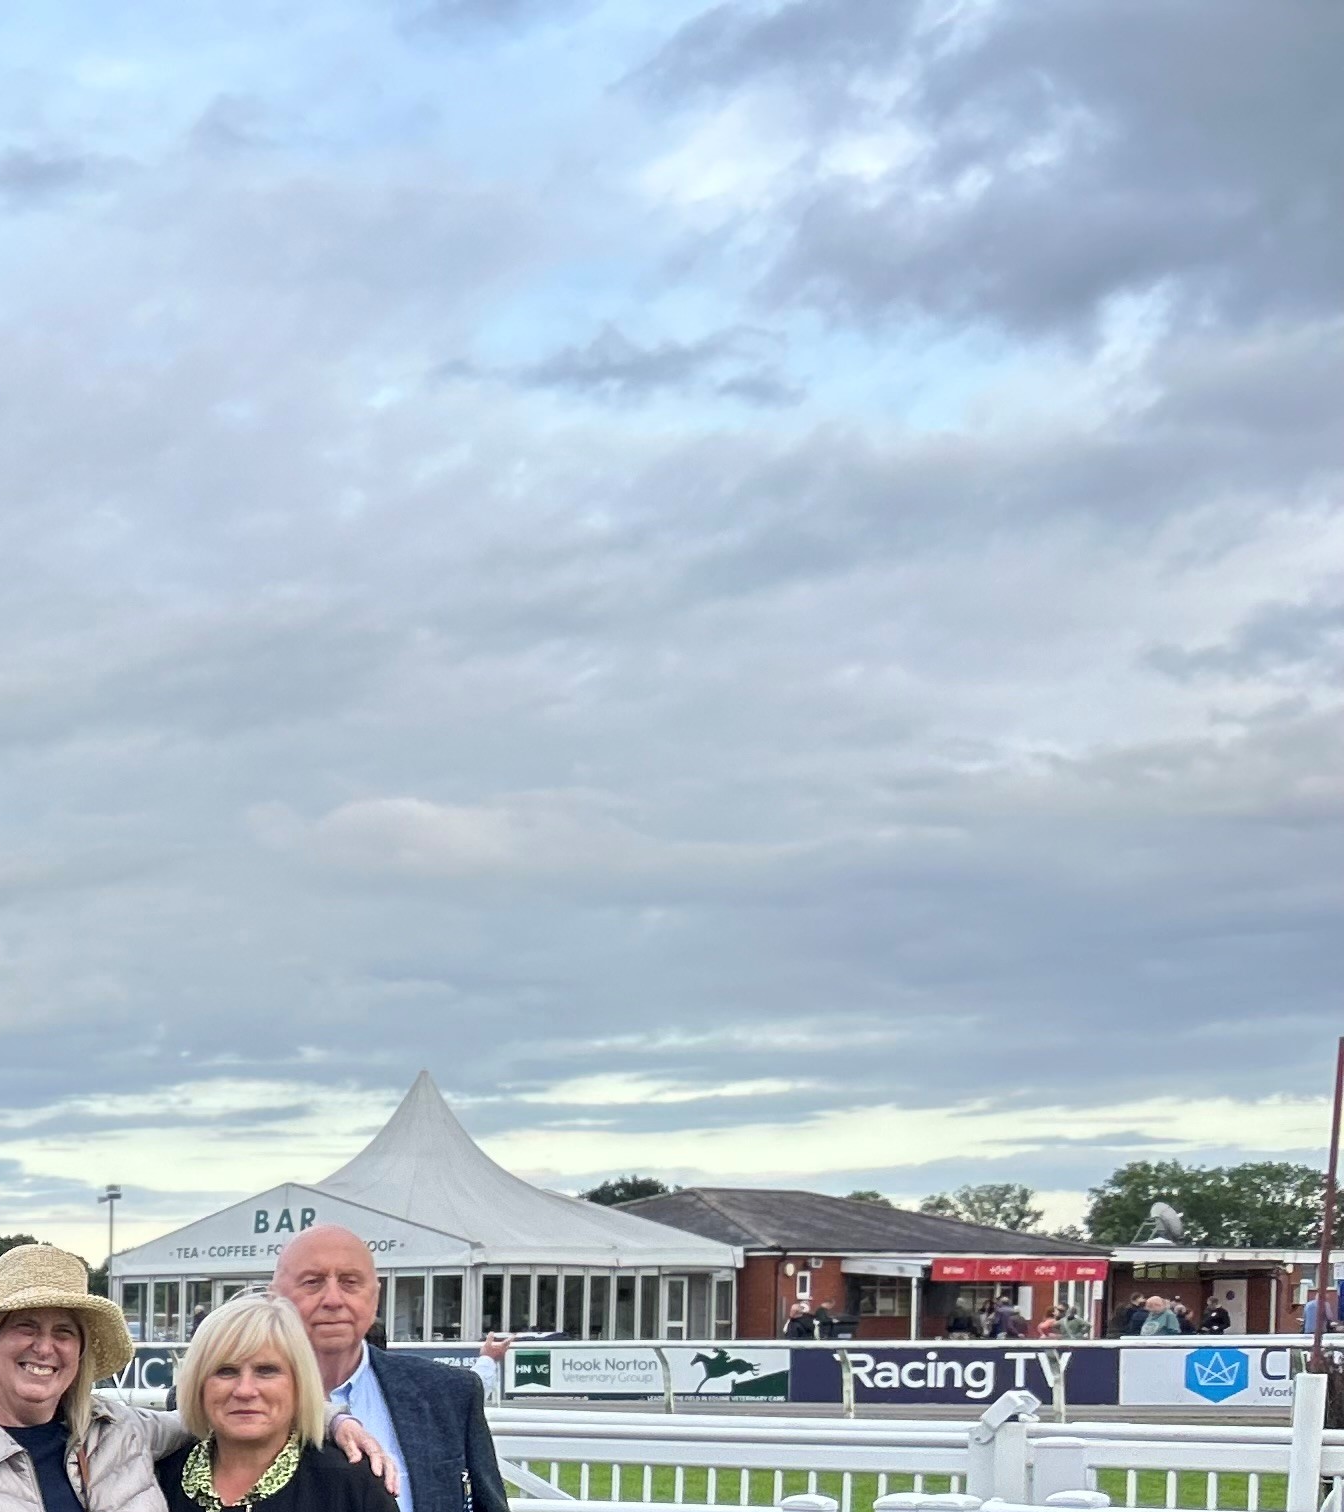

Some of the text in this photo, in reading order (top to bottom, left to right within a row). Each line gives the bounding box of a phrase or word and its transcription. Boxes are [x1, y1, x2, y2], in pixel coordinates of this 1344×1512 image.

[254, 1207, 316, 1233] BAR
[176, 1247, 198, 1259] TEA
[208, 1244, 257, 1258] COFFEE
[266, 1243, 283, 1256] FO
[516, 1365, 549, 1374] HN VG
[562, 1358, 658, 1371] Hook Norton
[1260, 1346, 1293, 1380] C
[562, 1373, 616, 1384] Veterinary
[834, 1352, 1072, 1399] Racing TV
